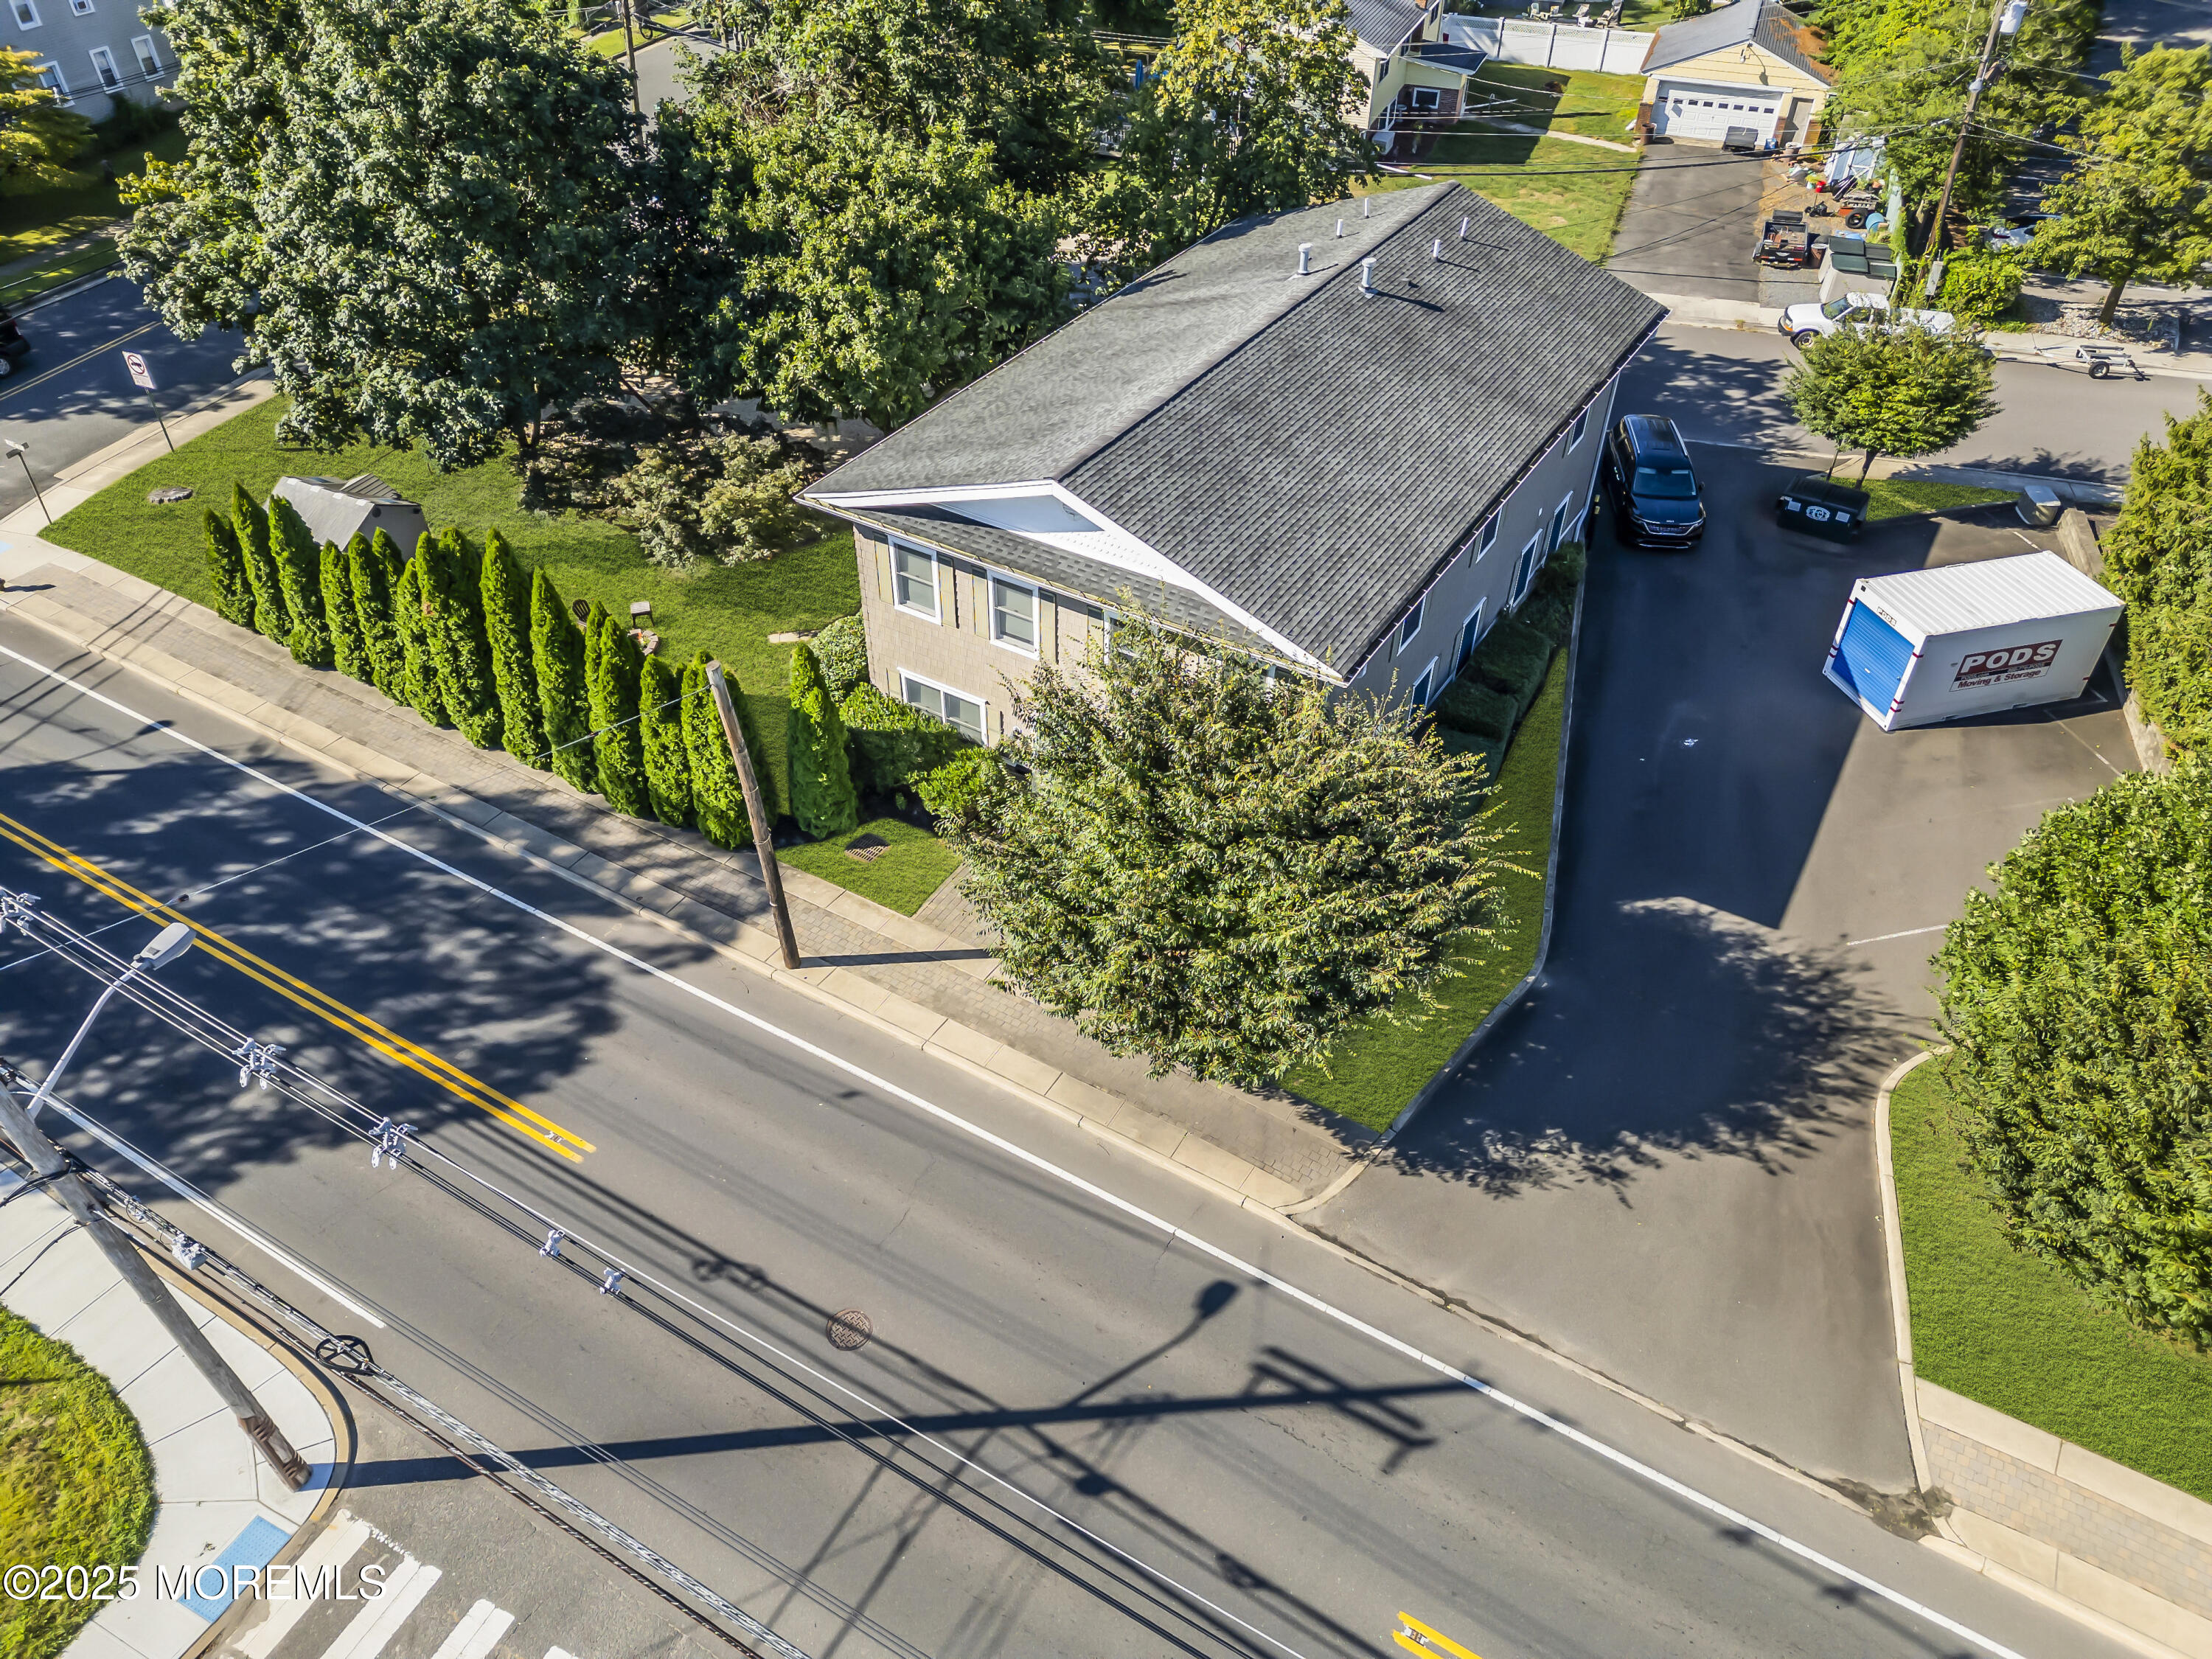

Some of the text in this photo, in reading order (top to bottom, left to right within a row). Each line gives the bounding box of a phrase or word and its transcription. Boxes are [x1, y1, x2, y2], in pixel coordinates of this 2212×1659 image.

[1877, 606, 1896, 627] PODS
[1961, 644, 2056, 673] PODS
[1958, 678, 1992, 688] Moving
[2004, 669, 2042, 681] Storage
